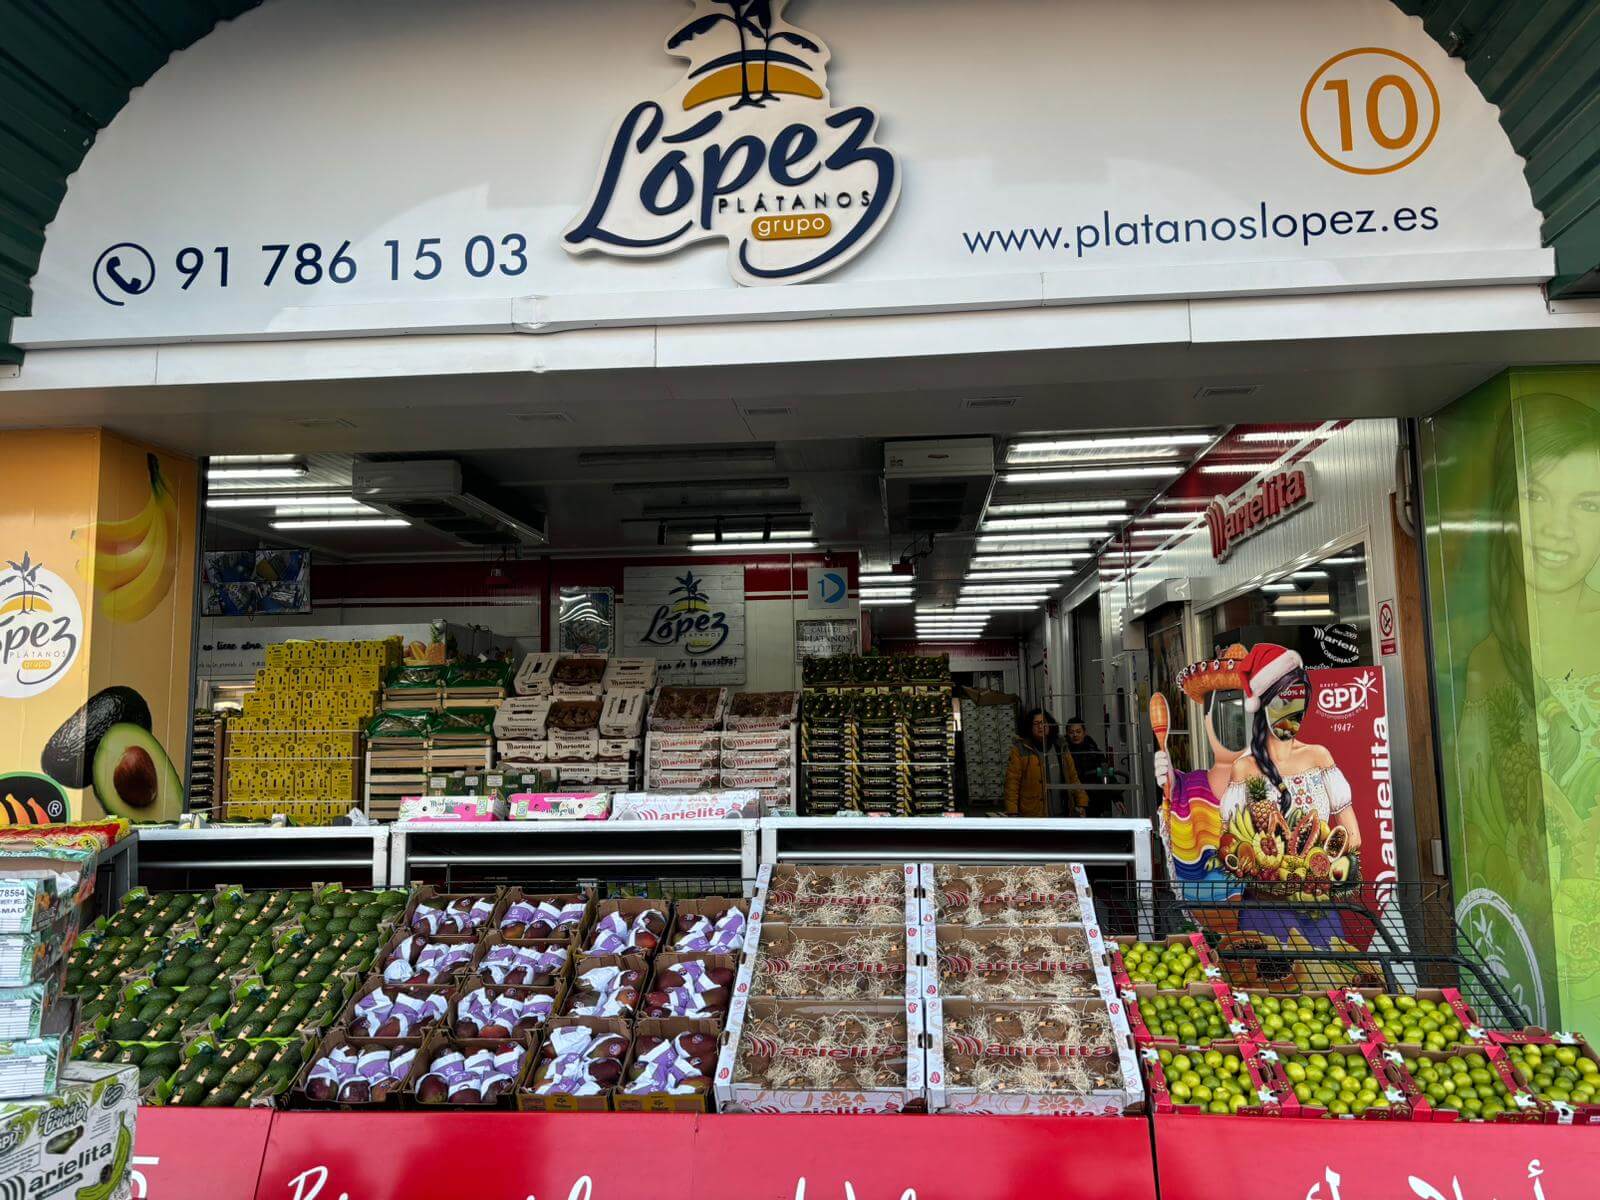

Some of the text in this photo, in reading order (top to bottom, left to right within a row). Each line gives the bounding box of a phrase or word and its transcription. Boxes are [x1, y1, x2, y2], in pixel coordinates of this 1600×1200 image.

[1323, 73, 1419, 152] 10
[564, 100, 894, 279] López
[718, 190, 871, 213] PLÁTANOS
[757, 215, 826, 237] grupo
[962, 201, 1439, 257] www.platanoslopez.es
[175, 232, 529, 290] 91 786 15 03
[640, 605, 729, 655] López
